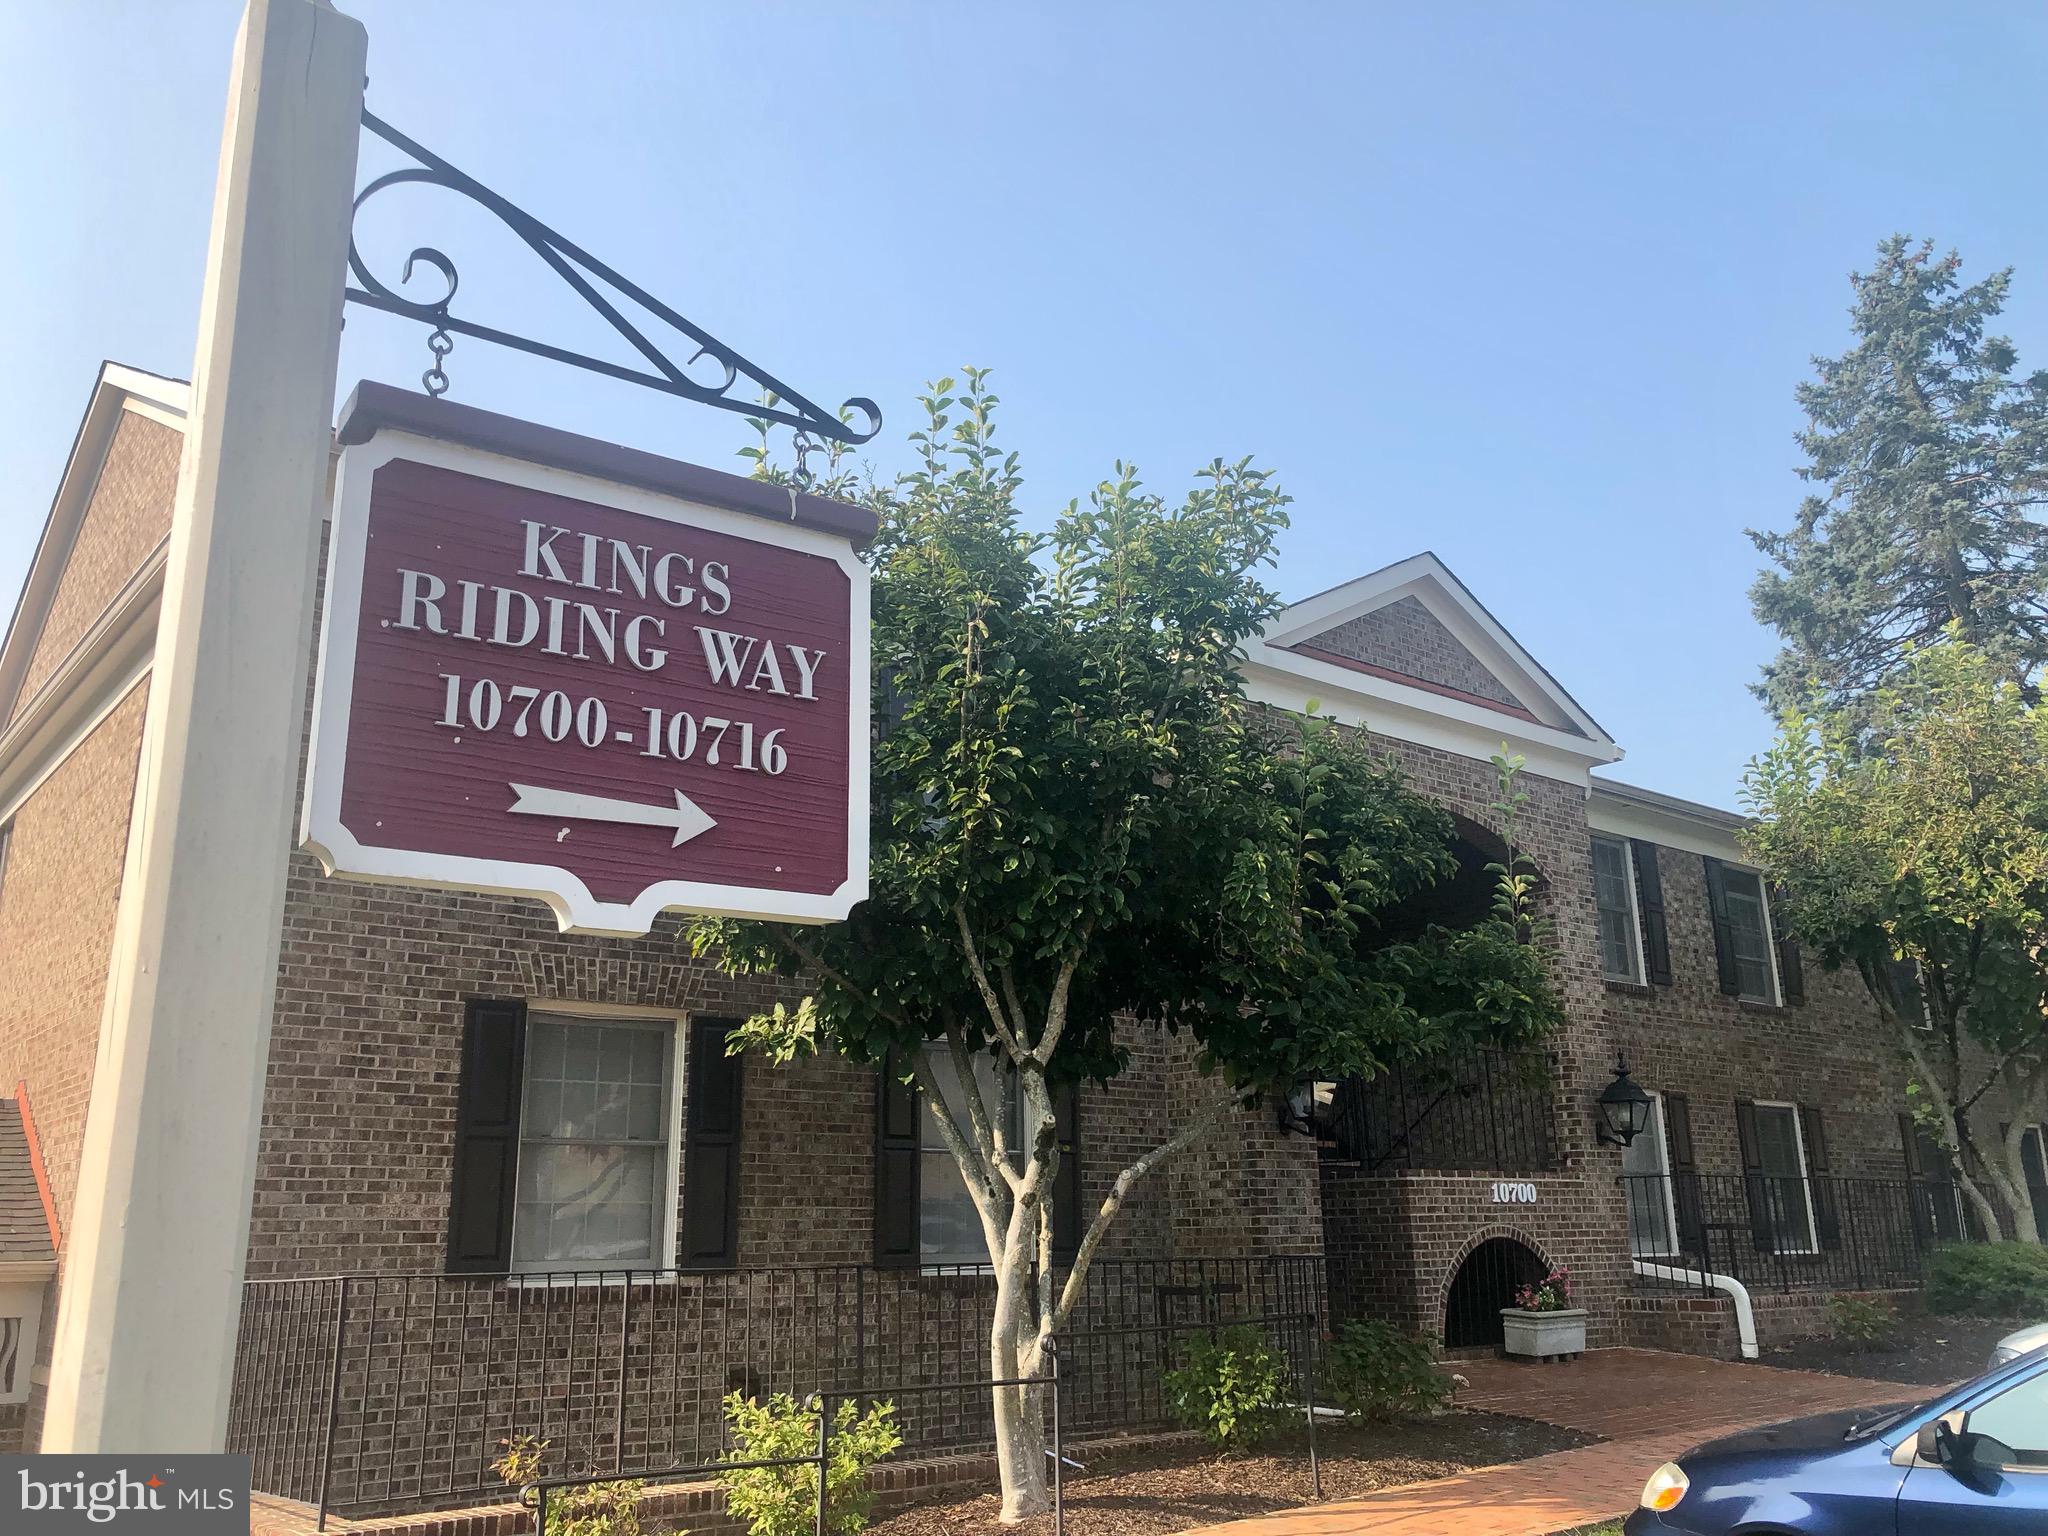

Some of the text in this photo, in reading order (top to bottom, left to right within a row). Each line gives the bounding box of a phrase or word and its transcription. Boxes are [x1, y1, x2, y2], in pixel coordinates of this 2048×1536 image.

[517, 519, 731, 616] KINGS
[392, 568, 826, 701] RIDING WAY
[434, 673, 788, 776] 10700-10716
[1491, 1183, 1537, 1203] 10700
